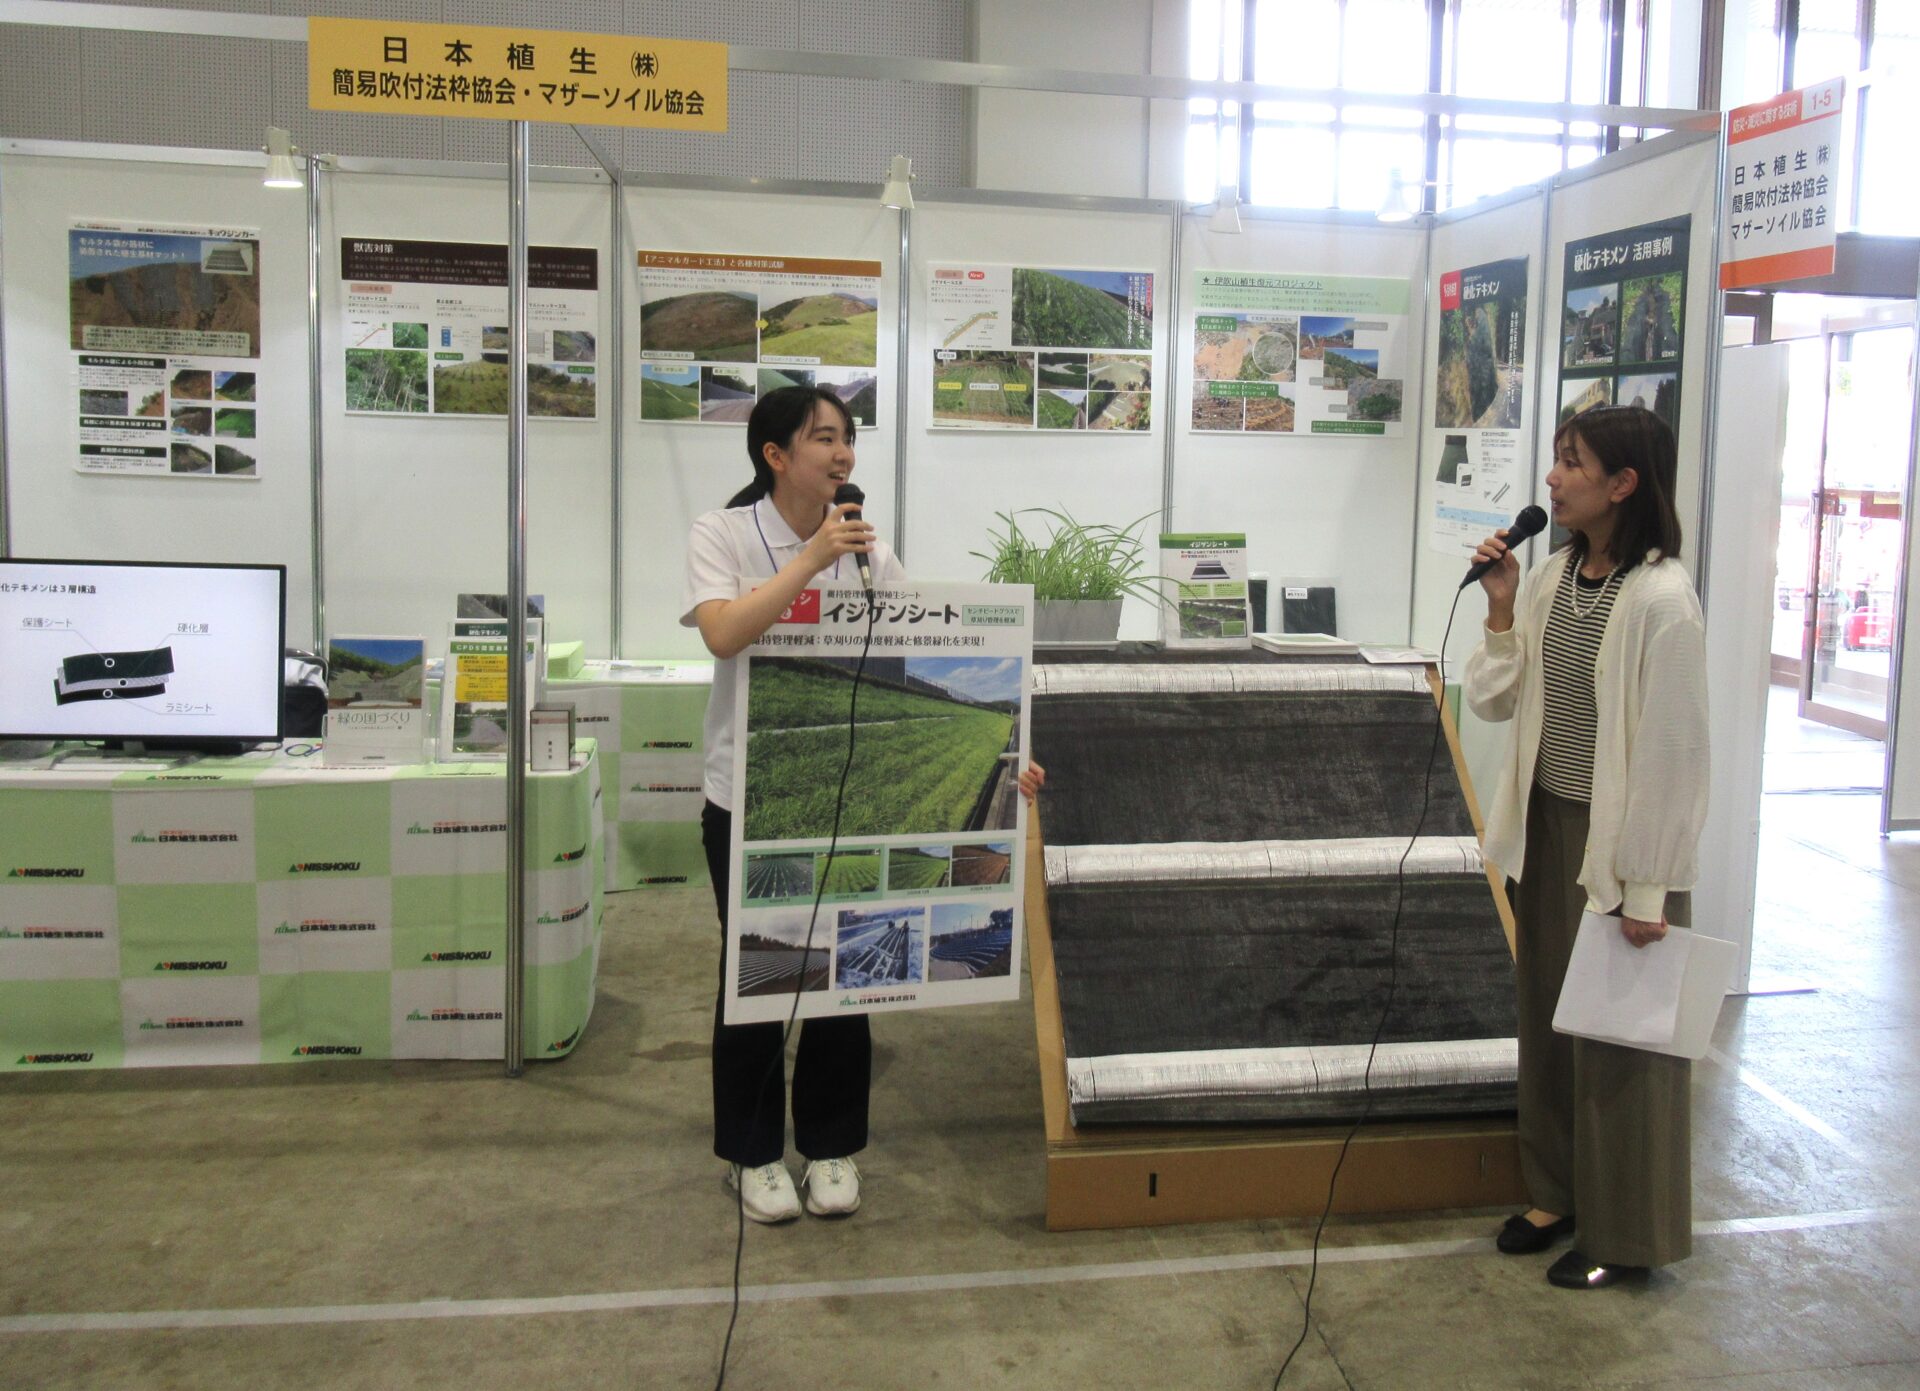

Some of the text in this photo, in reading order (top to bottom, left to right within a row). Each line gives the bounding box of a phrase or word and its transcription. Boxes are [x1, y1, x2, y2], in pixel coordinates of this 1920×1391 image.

[332, 68, 705, 116] 簡易吹付法枠協会・マザーソイル協会
[1811, 88, 1831, 111] 1-5
[1731, 174, 1829, 214] 簡易吹付法枠協会
[1731, 205, 1827, 241] マザーソイル協会
[1574, 236, 1673, 272] 硬化テキメン 活用事例
[0, 583, 96, 594] 化テキメンは3層構造
[824, 602, 959, 625] イジゲンシート
[22, 617, 73, 628] 保護シート
[177, 622, 209, 633] 硬化層
[166, 703, 212, 712] ラミシート
[24, 868, 84, 877] NISSHOKU
[303, 862, 360, 872] NISSHOKU
[438, 951, 491, 961] NISSHOKU
[170, 961, 227, 970] NISSHOKU
[307, 1046, 362, 1055] NISSHOKU
[33, 1053, 93, 1063] NISSHOKU
